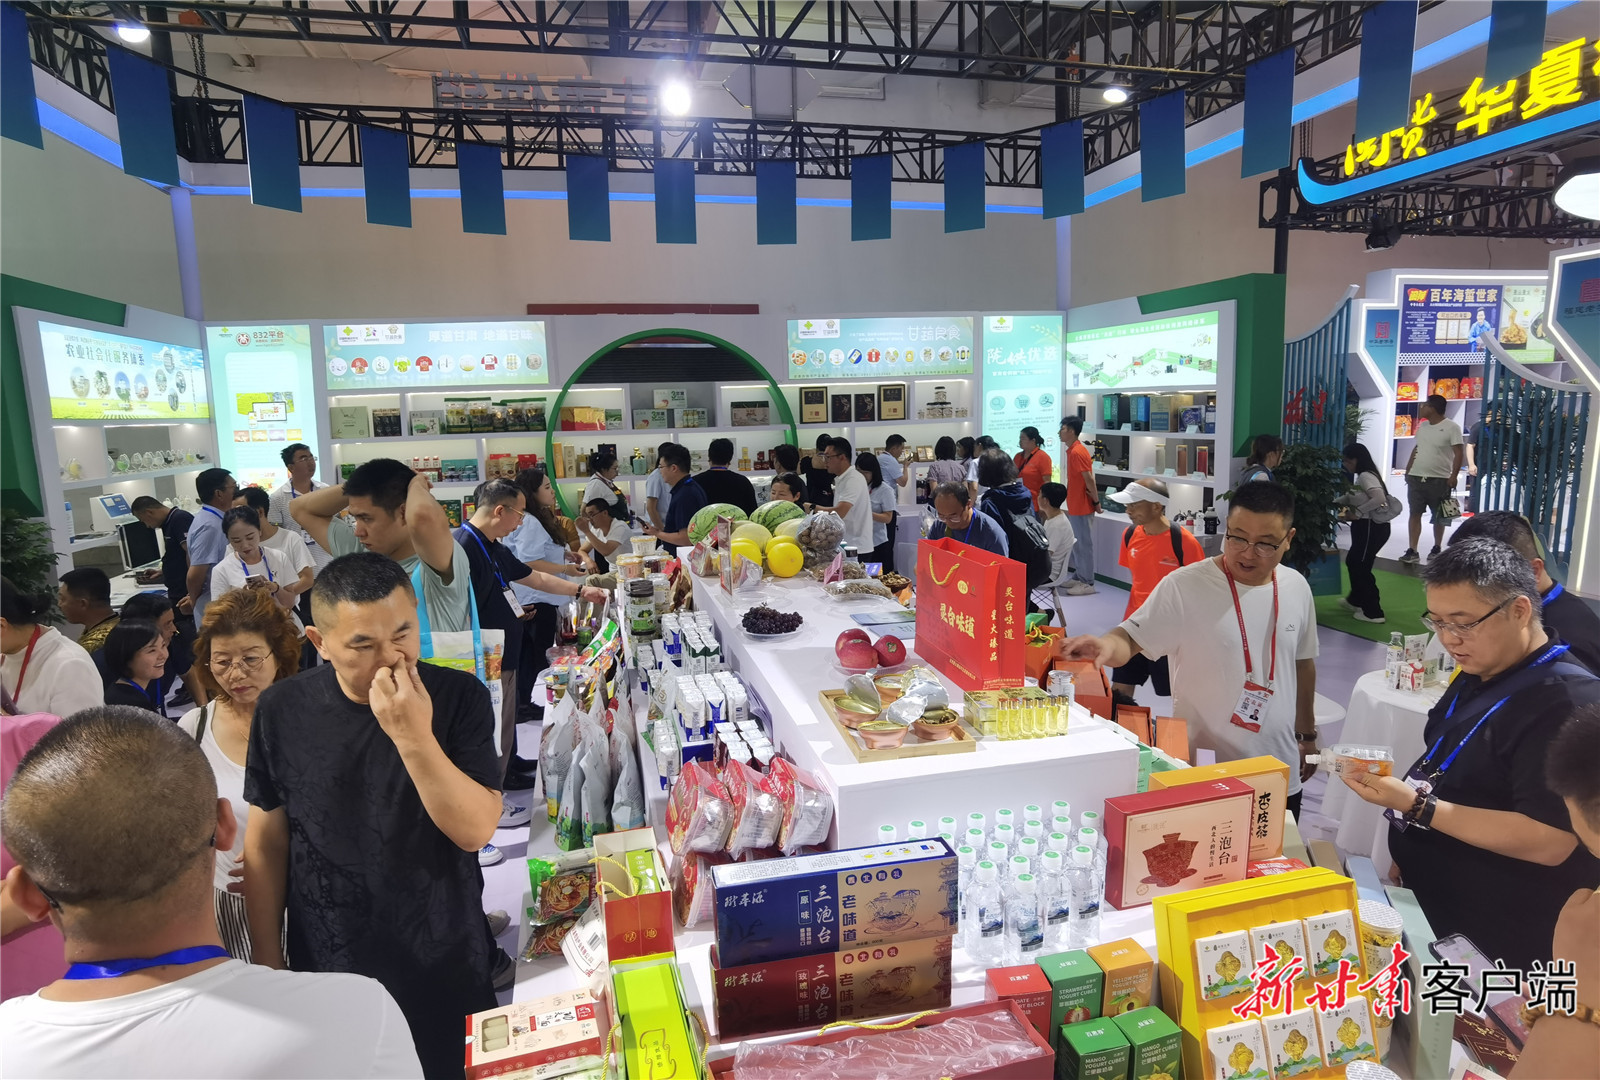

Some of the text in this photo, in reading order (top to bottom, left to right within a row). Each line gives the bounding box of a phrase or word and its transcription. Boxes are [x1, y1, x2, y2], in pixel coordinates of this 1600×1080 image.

[253, 331, 284, 339] 832平台
[65, 343, 145, 366] 农业社会化服务体系
[1003, 587, 1015, 640] 灵台味道
[1256, 791, 1272, 840] 杏皮茶
[1218, 820, 1233, 866] 三泡台
[800, 895, 810, 920] 原味
[814, 884, 834, 944] 三泡台
[842, 895, 857, 942] 老味道
[812, 964, 832, 1019] 三泡台
[839, 973, 854, 1017] 老味道
[1058, 988, 1097, 1000] YOGURT CUBES
[1059, 984, 1093, 995] STRAWBERRY
[1141, 1043, 1161, 1052] MANGO
[1141, 1043, 1178, 1059] YOGURT CUBES
[1084, 1057, 1126, 1069] YOGURT CUBES
[1085, 1056, 1106, 1064] MANGO
